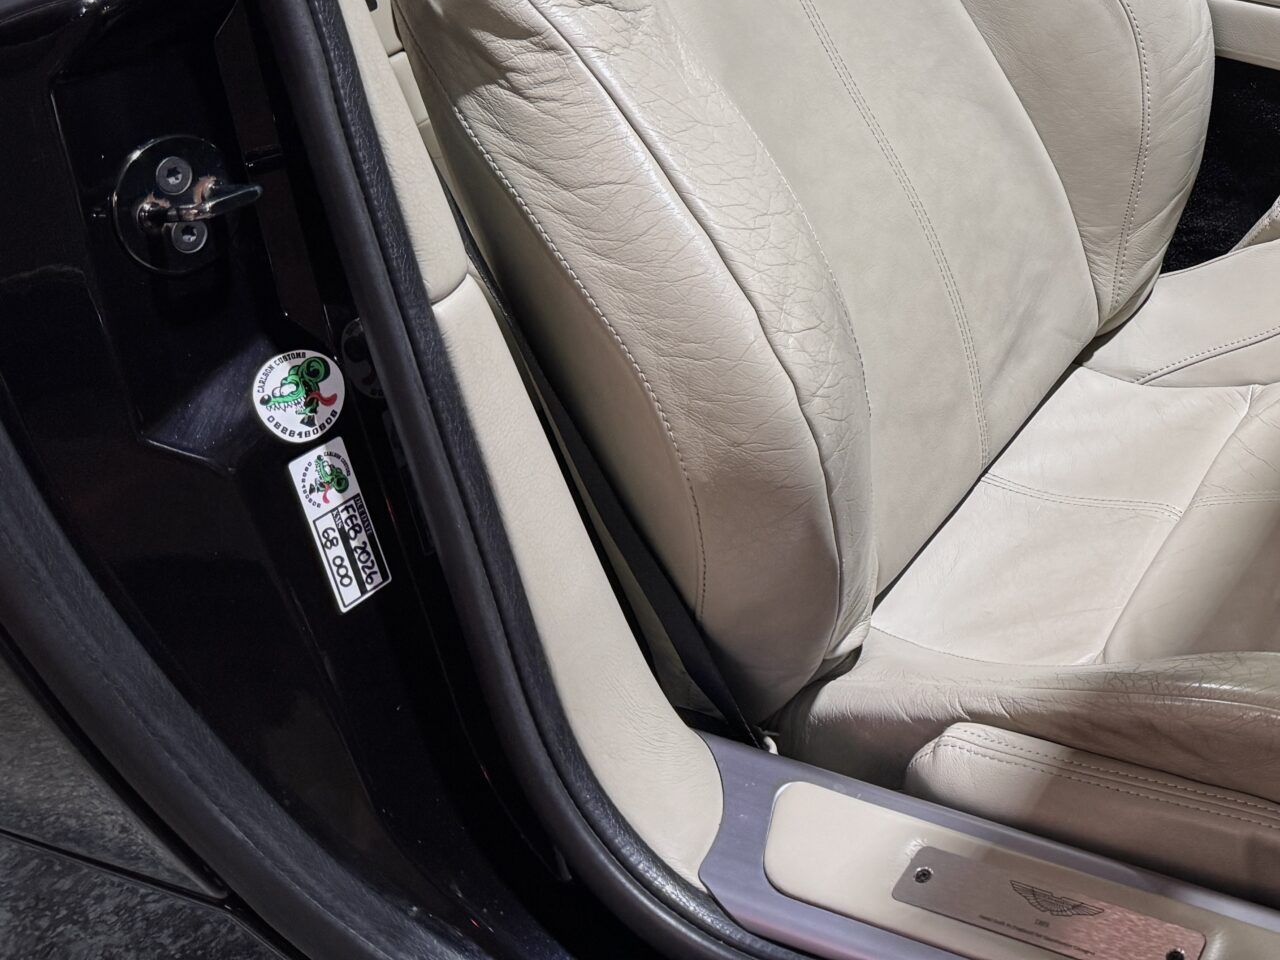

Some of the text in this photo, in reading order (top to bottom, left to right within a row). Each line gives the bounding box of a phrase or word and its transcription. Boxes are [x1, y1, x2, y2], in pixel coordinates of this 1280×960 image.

[257, 352, 306, 393] CARLSON CUSTOMS
[321, 526, 353, 588] 68 000
[340, 503, 378, 586] FEB 2026
